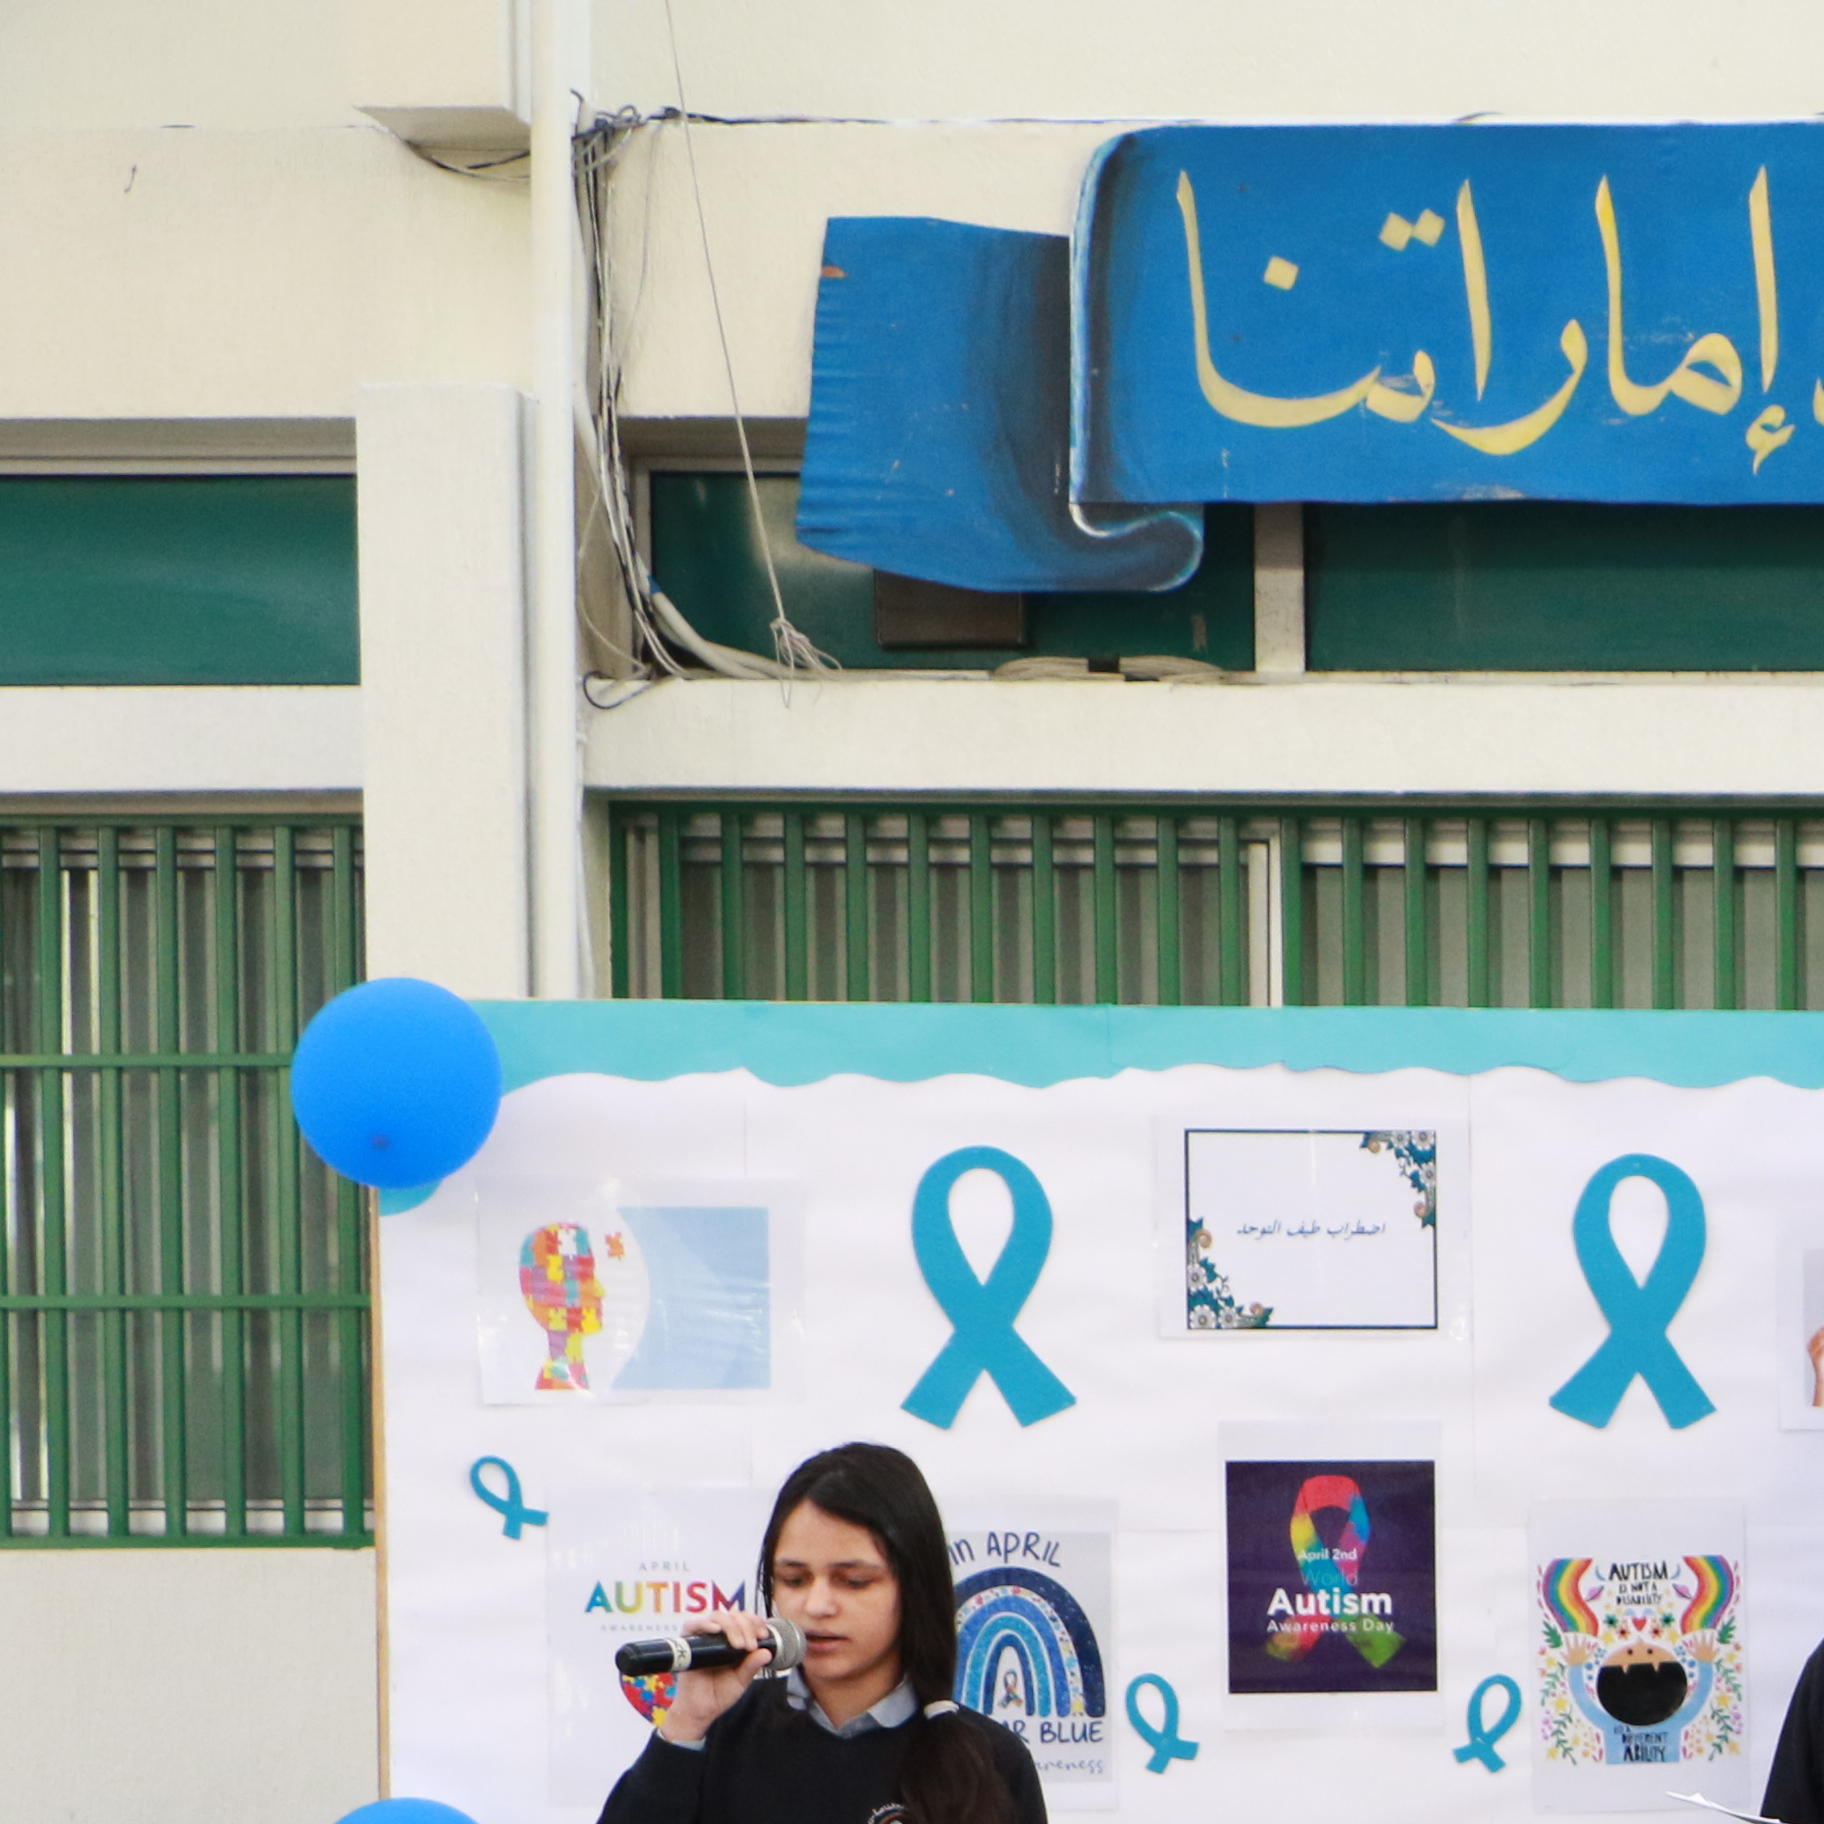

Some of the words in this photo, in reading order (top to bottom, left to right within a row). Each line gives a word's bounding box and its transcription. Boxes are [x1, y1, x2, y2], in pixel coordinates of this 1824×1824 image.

[1175, 163, 1795, 476] إماراتنا
[1237, 1219, 1282, 1240] التوحد
[1286, 1219, 1321, 1238] طيف
[1326, 1219, 1386, 1241] اضطراب
[986, 1531, 1062, 1568] APRIL
[1298, 1549, 1330, 1565] April
[1332, 1548, 1358, 1561] 2nd
[638, 1561, 690, 1572] APRIL
[1608, 1560, 1669, 1581] AUTISM
[1302, 1568, 1358, 1587] World
[584, 1579, 746, 1614] AUTISM
[1266, 1587, 1393, 1616] Autism
[600, 1624, 679, 1633] AWARENESS
[1266, 1619, 1357, 1633] Awareness
[1362, 1618, 1394, 1635] Day
[1040, 1719, 1104, 1744] BLUE
[1623, 1743, 1666, 1762] ABILITY
